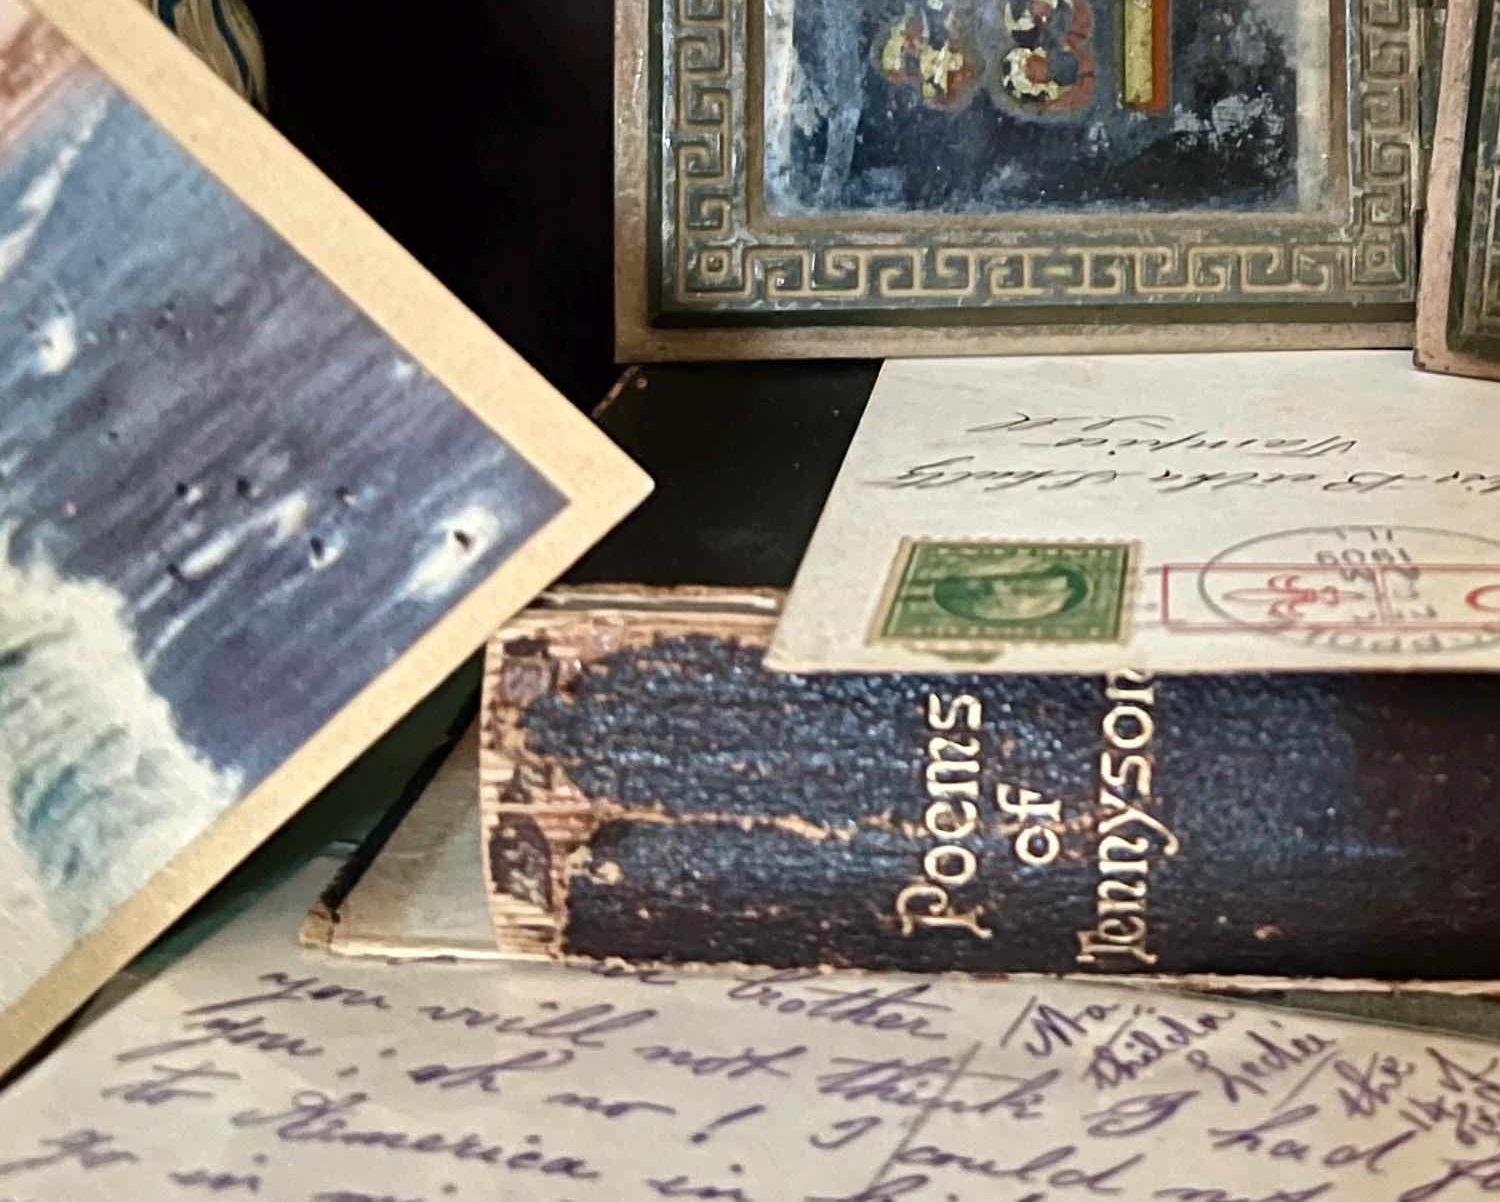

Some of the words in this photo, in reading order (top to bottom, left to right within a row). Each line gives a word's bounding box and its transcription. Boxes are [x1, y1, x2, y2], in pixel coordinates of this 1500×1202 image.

[896, 693, 993, 939] Poems
[996, 783, 1063, 866] of
[1075, 668, 1181, 965] Tennyson
[182, 971, 391, 1016] you
[417, 1002, 657, 1048] will
[633, 1044, 807, 1079] not
[1208, 1103, 1416, 1175] had
[229, 1089, 601, 1179] America
